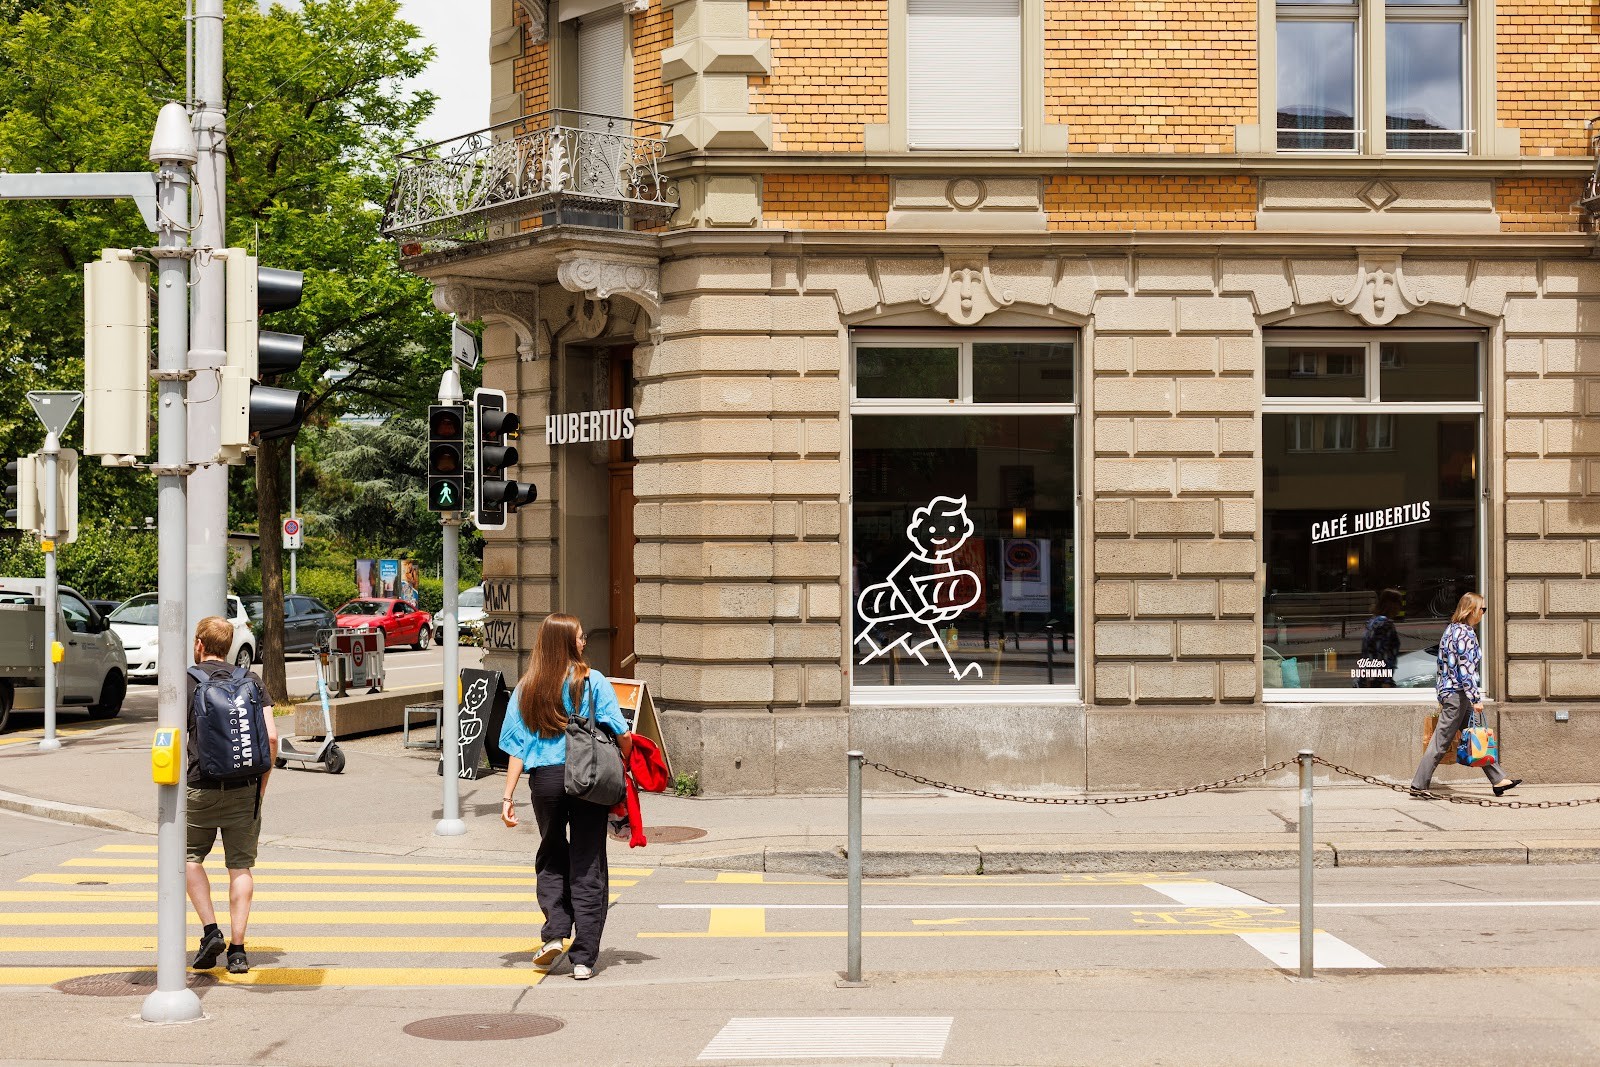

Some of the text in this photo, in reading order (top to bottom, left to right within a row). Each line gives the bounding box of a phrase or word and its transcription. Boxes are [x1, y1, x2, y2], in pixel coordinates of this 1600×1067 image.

[546, 408, 635, 445] HUBERTUS
[1312, 500, 1431, 540] CAFÉ HUBERTUS
[1350, 668, 1393, 678] BUCHMANN
[1356, 657, 1387, 668] Walter
[234, 695, 253, 767] MAMMUT
